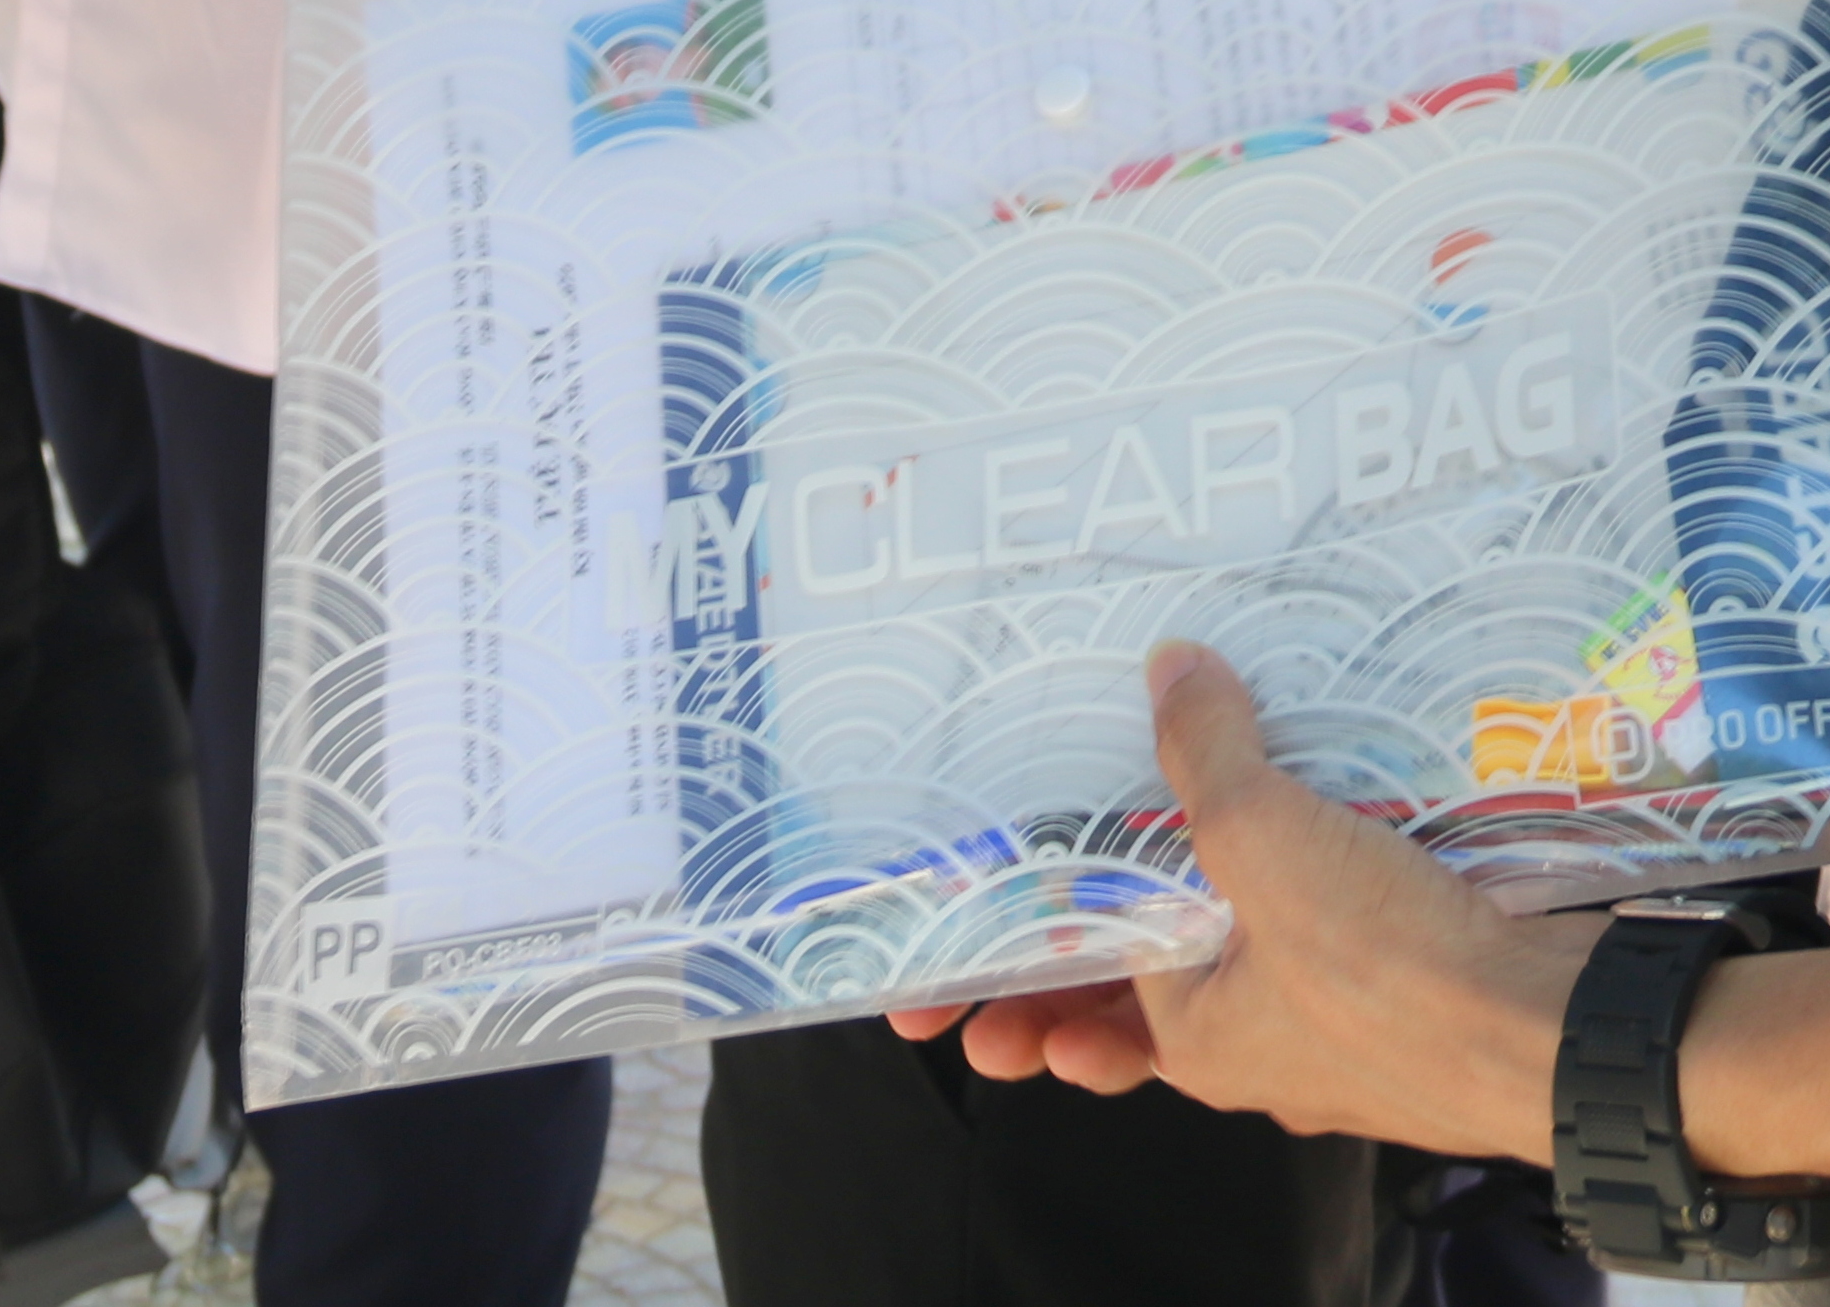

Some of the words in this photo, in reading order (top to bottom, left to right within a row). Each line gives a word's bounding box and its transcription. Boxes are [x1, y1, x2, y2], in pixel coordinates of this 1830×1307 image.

[605, 481, 771, 631] MY
[793, 405, 1295, 595] CLEAR
[1336, 332, 1572, 506] BAG
[313, 921, 384, 981] PP
